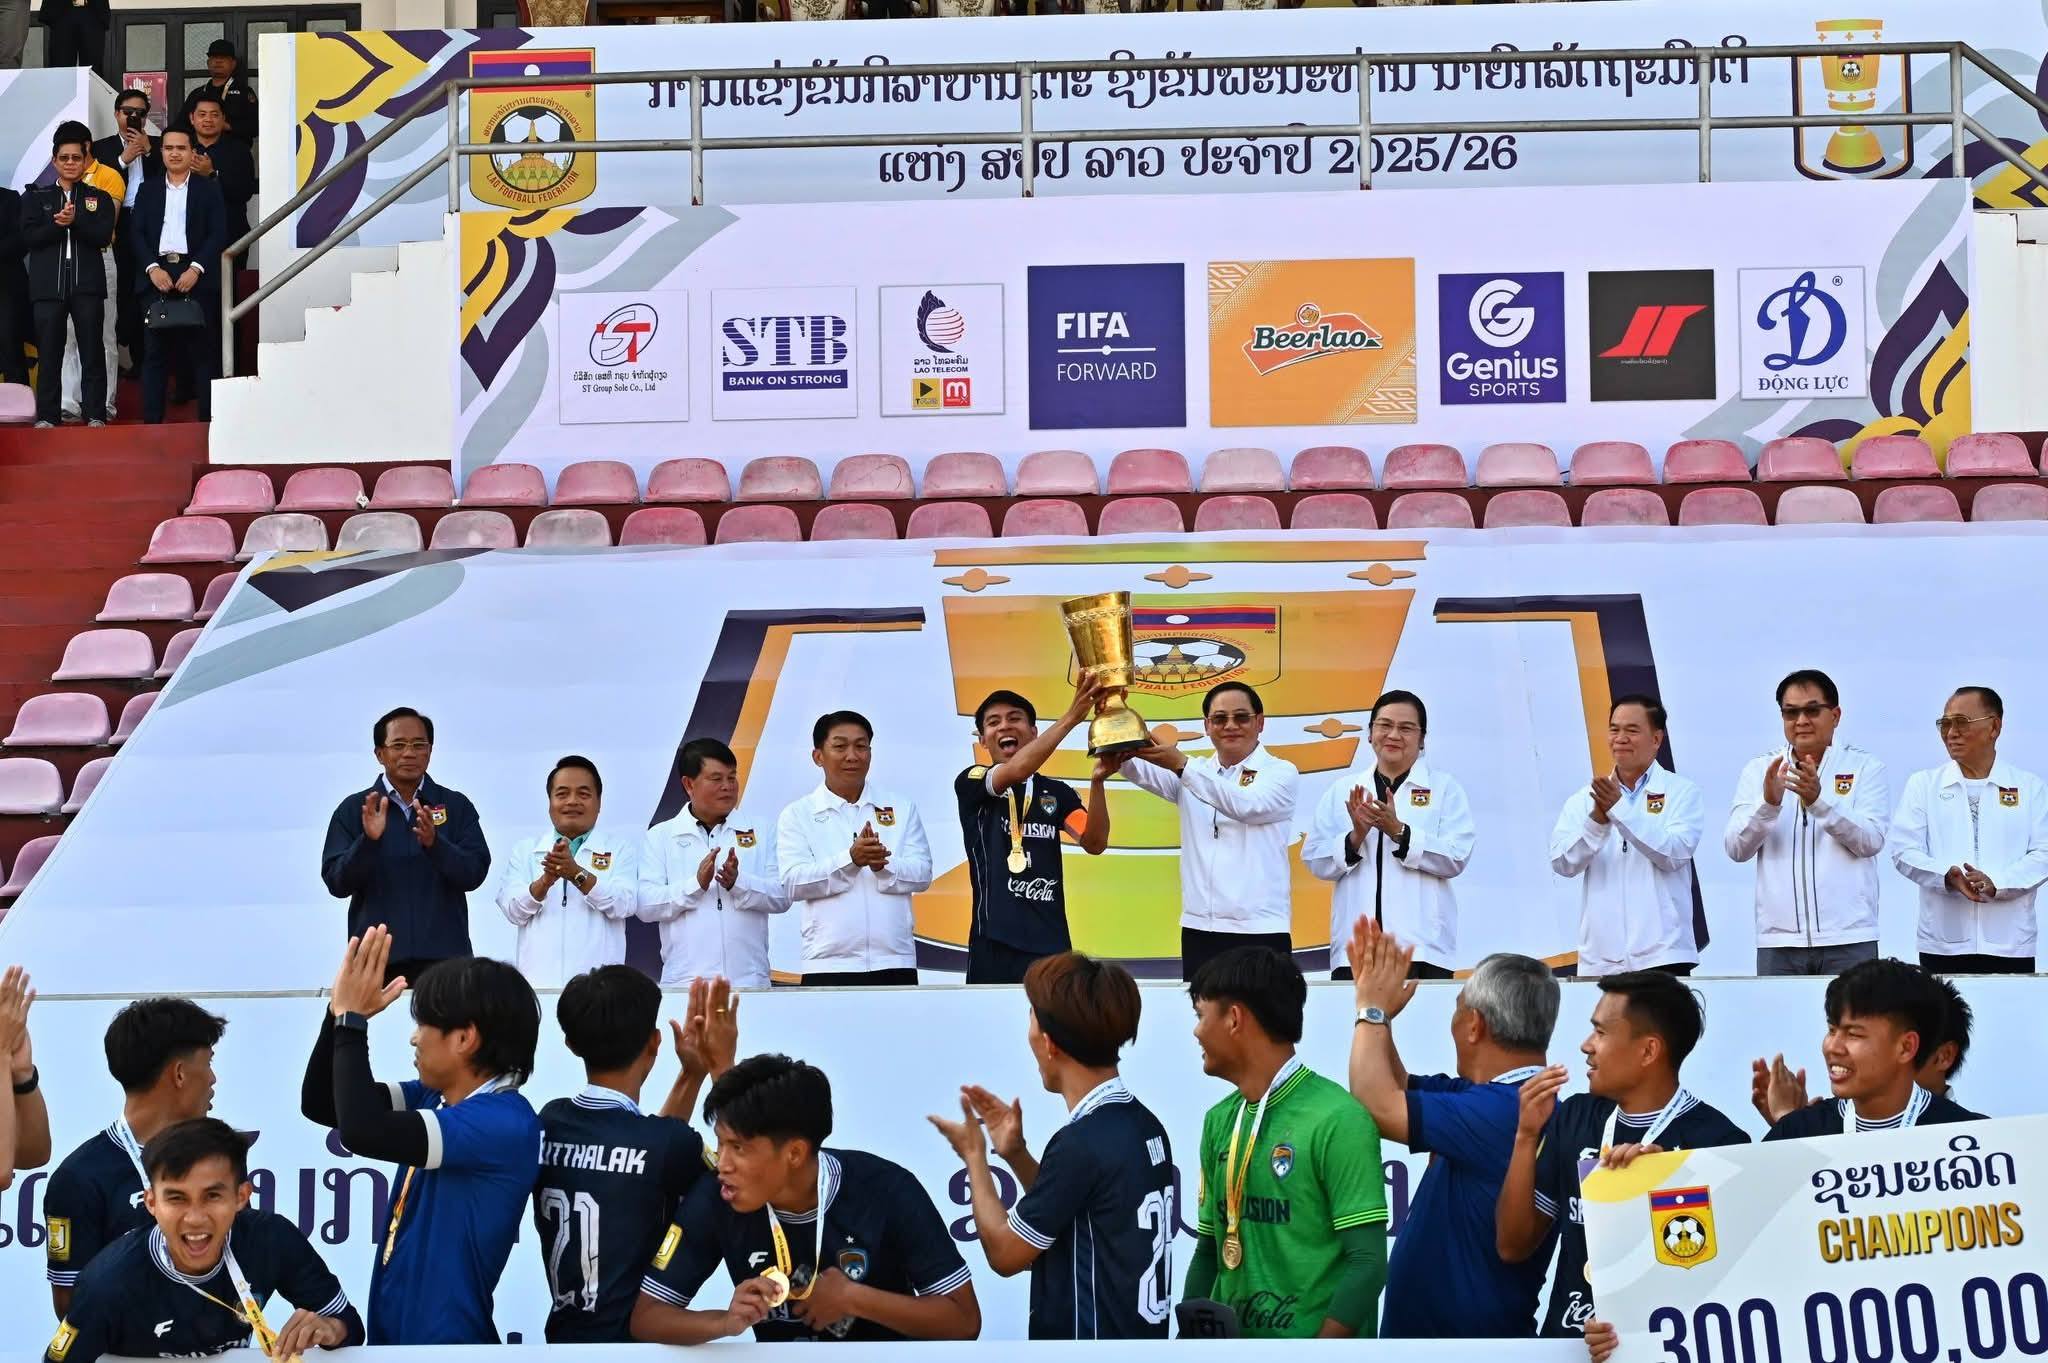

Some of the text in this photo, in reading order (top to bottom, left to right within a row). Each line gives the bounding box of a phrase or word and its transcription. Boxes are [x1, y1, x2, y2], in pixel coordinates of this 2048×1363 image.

[879, 144, 966, 192] ແຫງ
[1085, 146, 1165, 179] ລາວ
[1328, 133, 1518, 173] 2025/26
[486, 170, 580, 204] LAO FOOTBALL FEDERATION
[722, 314, 848, 367] STB
[1057, 311, 1130, 339] FIFA
[1253, 324, 1368, 351] Beerlao
[729, 373, 842, 386] BANK ON STRONG
[1057, 361, 1157, 382] FORWARD
[1447, 350, 1559, 381] Genius
[582, 384, 591, 393] ST
[593, 384, 613, 394] Group
[645, 382, 656, 392] Ltd
[1469, 381, 1540, 397] SPORTS
[1811, 1135, 2016, 1214] ຊະນະເລີດ
[1818, 1202, 2024, 1263] CHAMPIONS
[540, 1187, 600, 1313] 21
